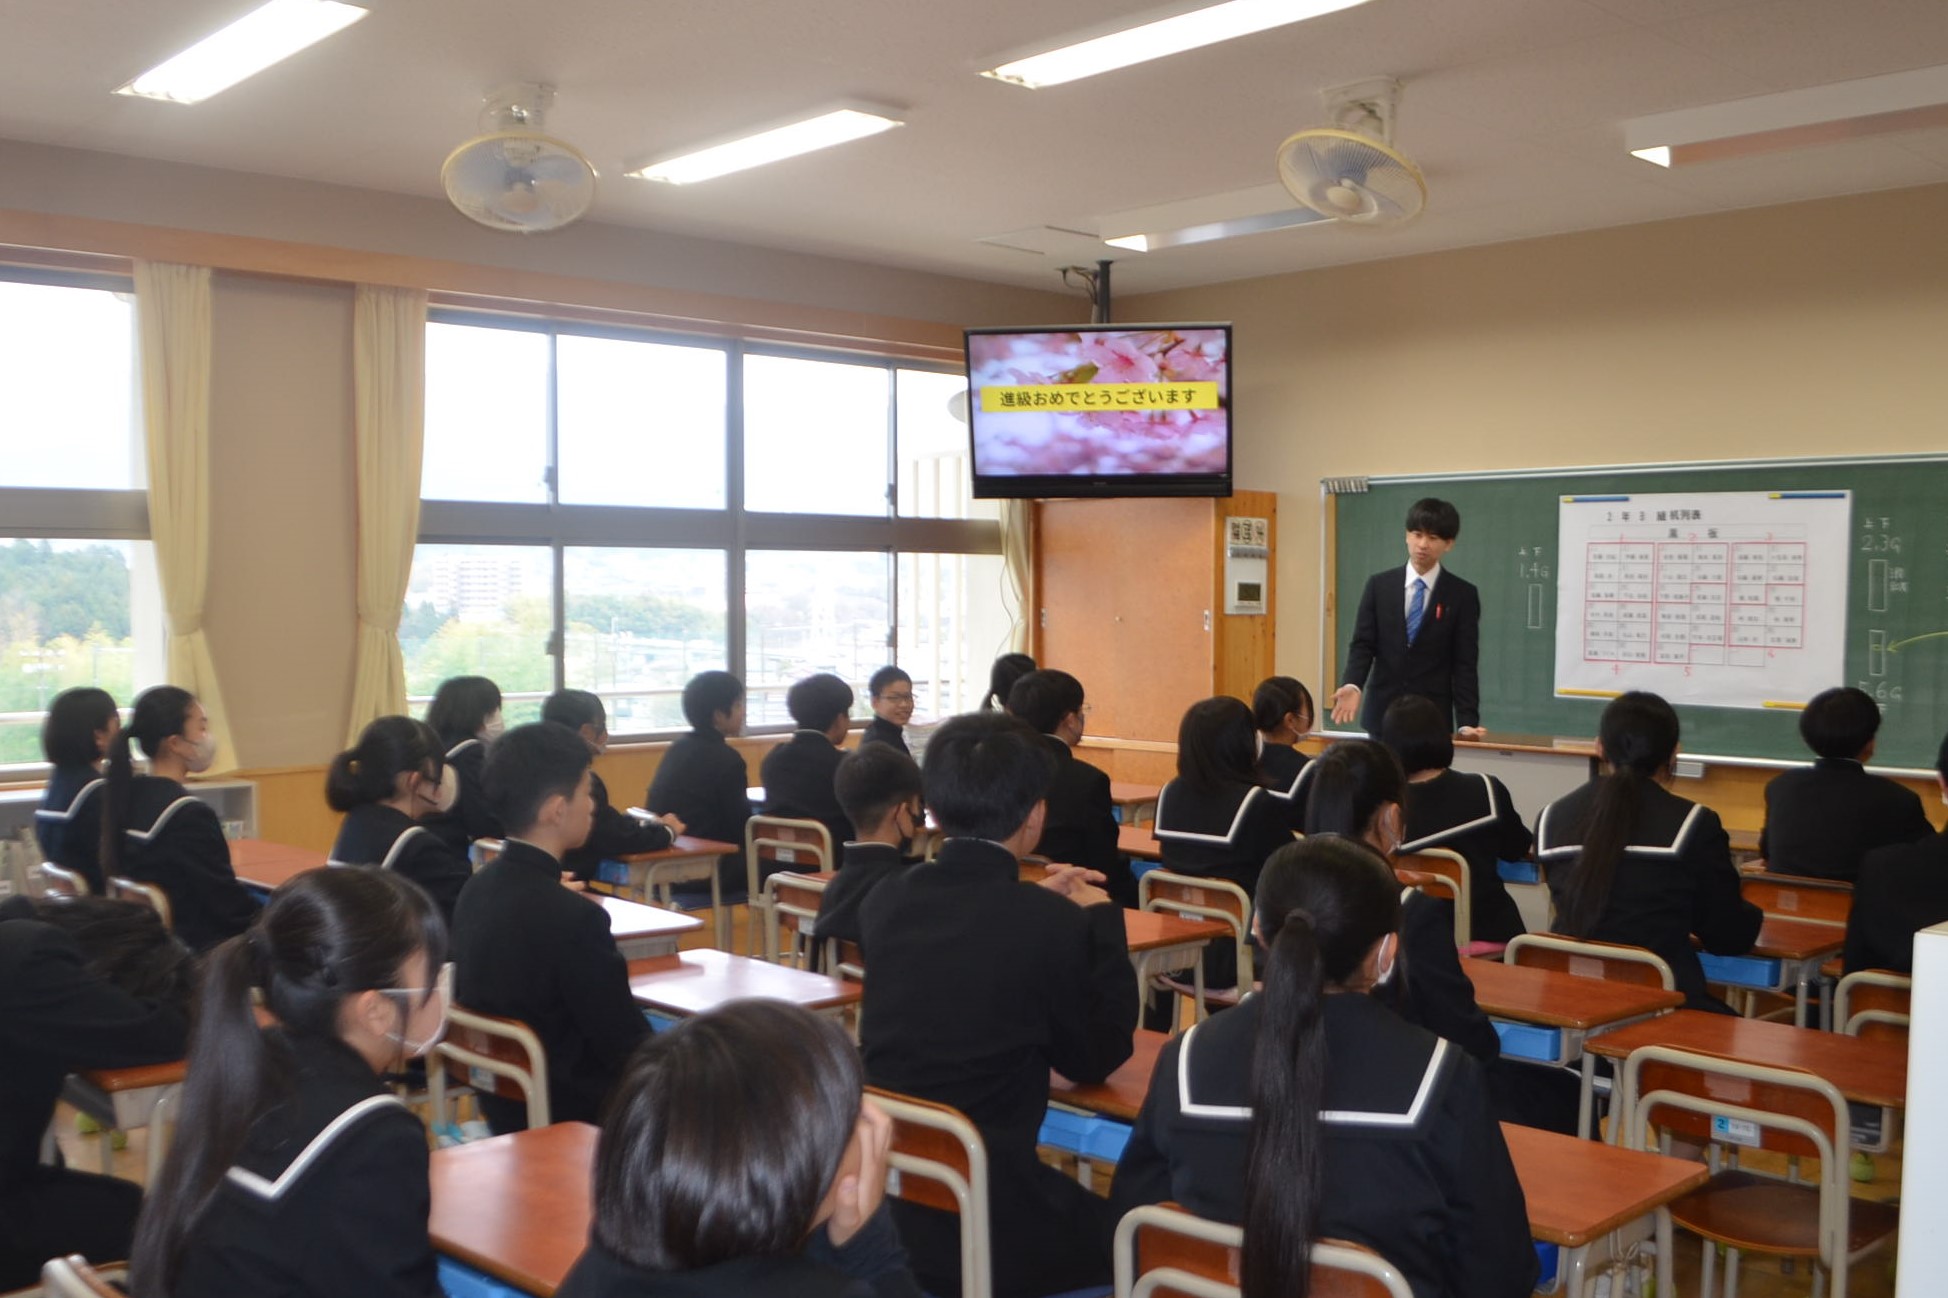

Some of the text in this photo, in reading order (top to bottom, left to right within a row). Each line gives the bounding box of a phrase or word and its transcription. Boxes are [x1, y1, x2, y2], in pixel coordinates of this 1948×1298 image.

[1000, 389, 1197, 407] 進級おめでとうございます
